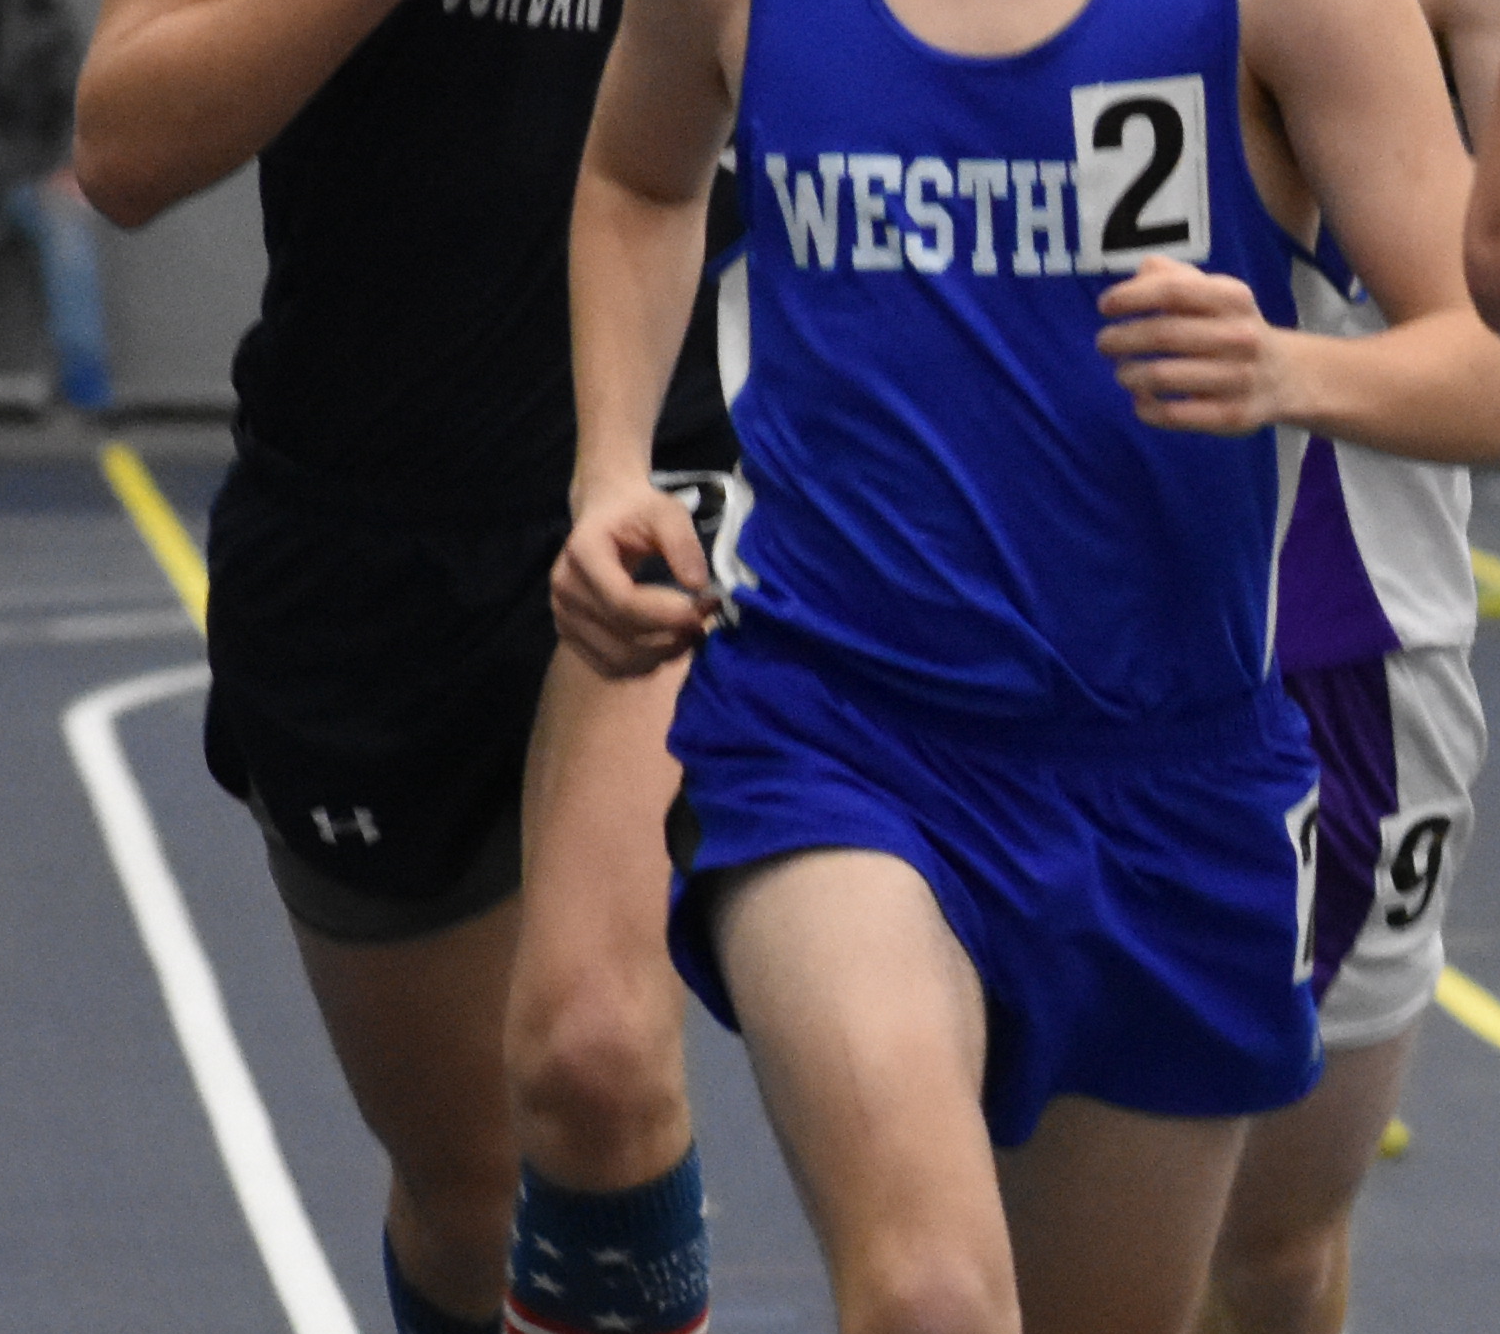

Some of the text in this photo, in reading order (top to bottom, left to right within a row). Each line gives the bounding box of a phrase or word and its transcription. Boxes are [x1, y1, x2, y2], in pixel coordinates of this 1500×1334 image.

[765, 152, 1082, 276] WESTH
[1092, 97, 1190, 253] 2
[1386, 815, 1451, 931] 9
